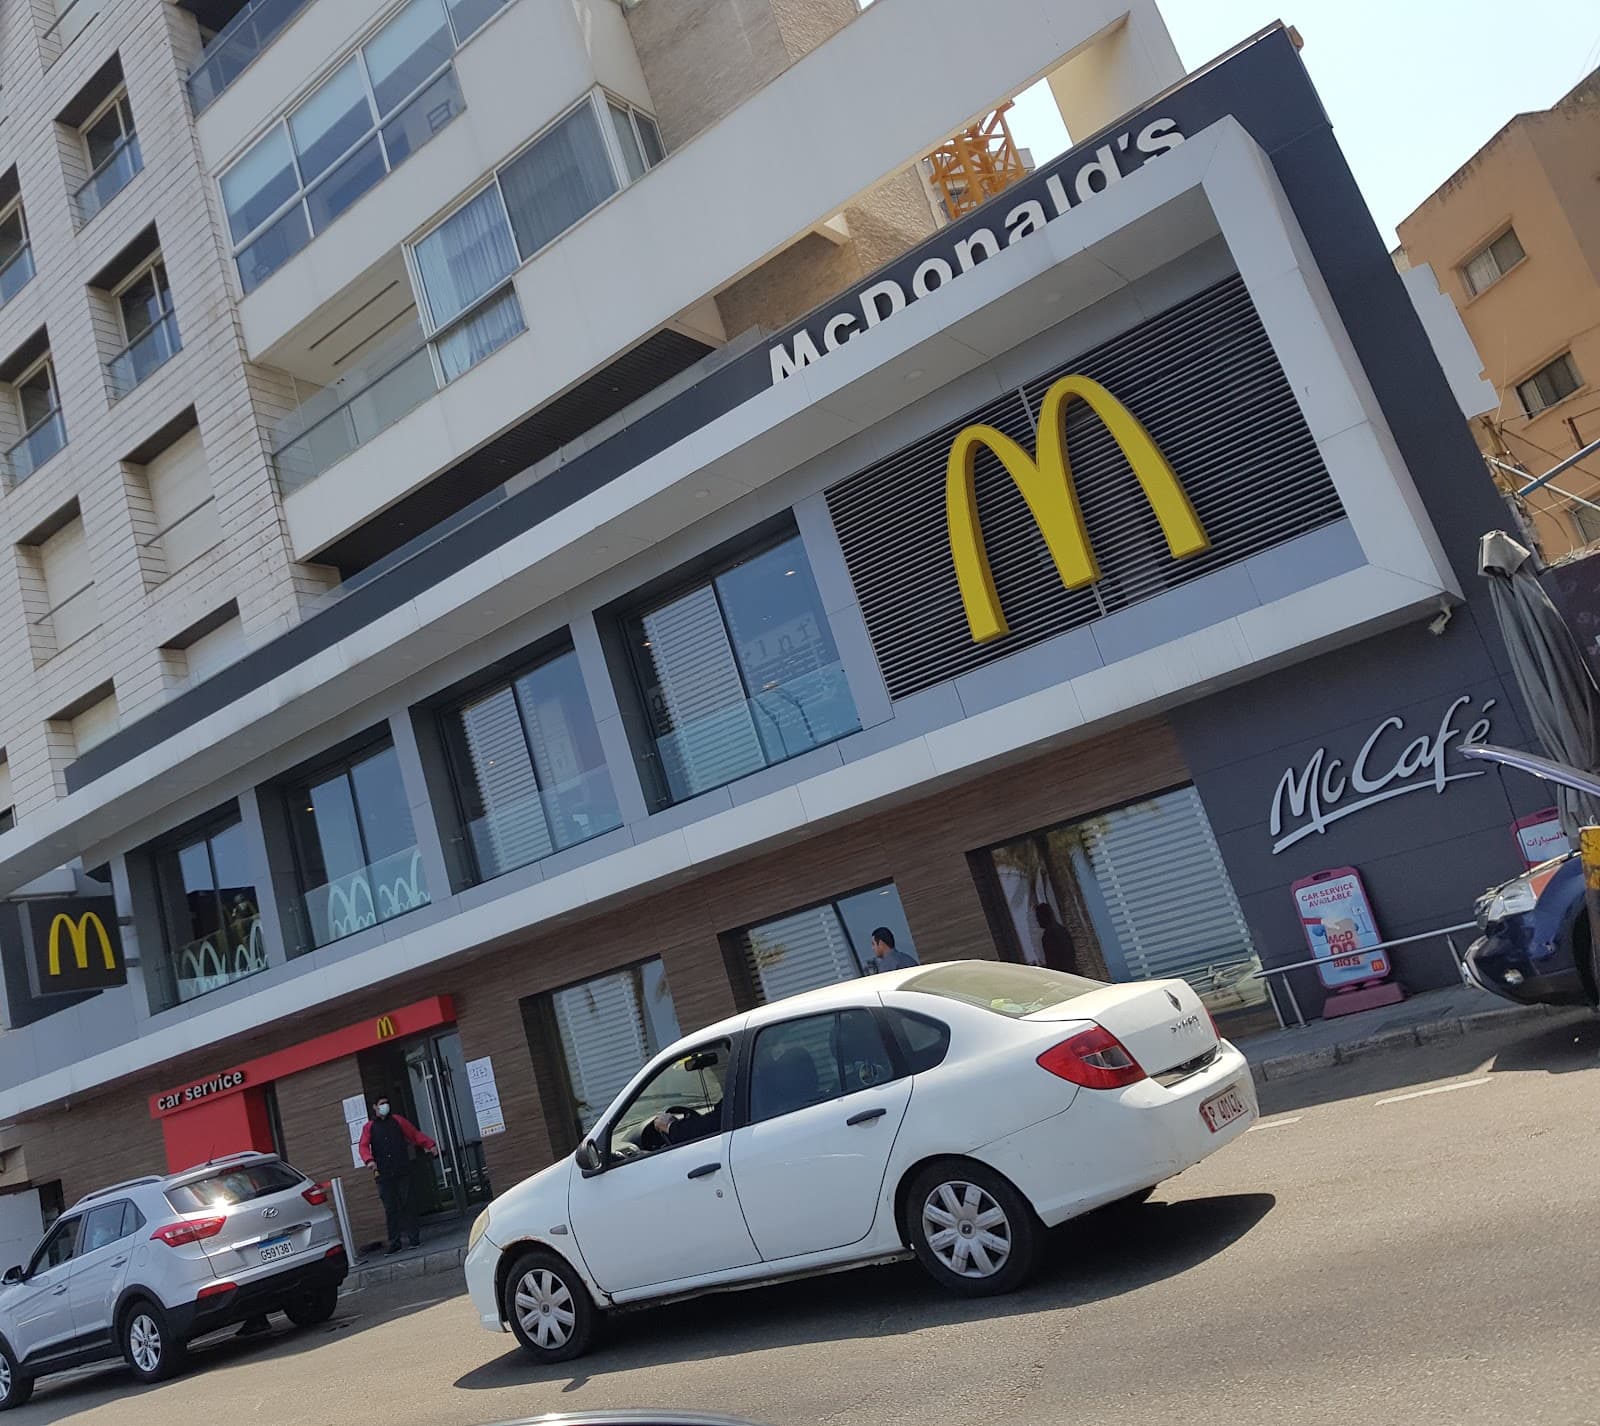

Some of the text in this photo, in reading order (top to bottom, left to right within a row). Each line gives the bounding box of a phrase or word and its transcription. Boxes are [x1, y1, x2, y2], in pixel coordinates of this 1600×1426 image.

[769, 117, 1186, 385] McDonald's
[1270, 695, 1497, 838] McCafé
[1301, 882, 1355, 902] CAR SERVICE
[1309, 890, 1353, 908] AVAILABLE
[1327, 930, 1353, 945] McD
[157, 1071, 243, 1111] car service
[260, 1242, 294, 1261] G591381
